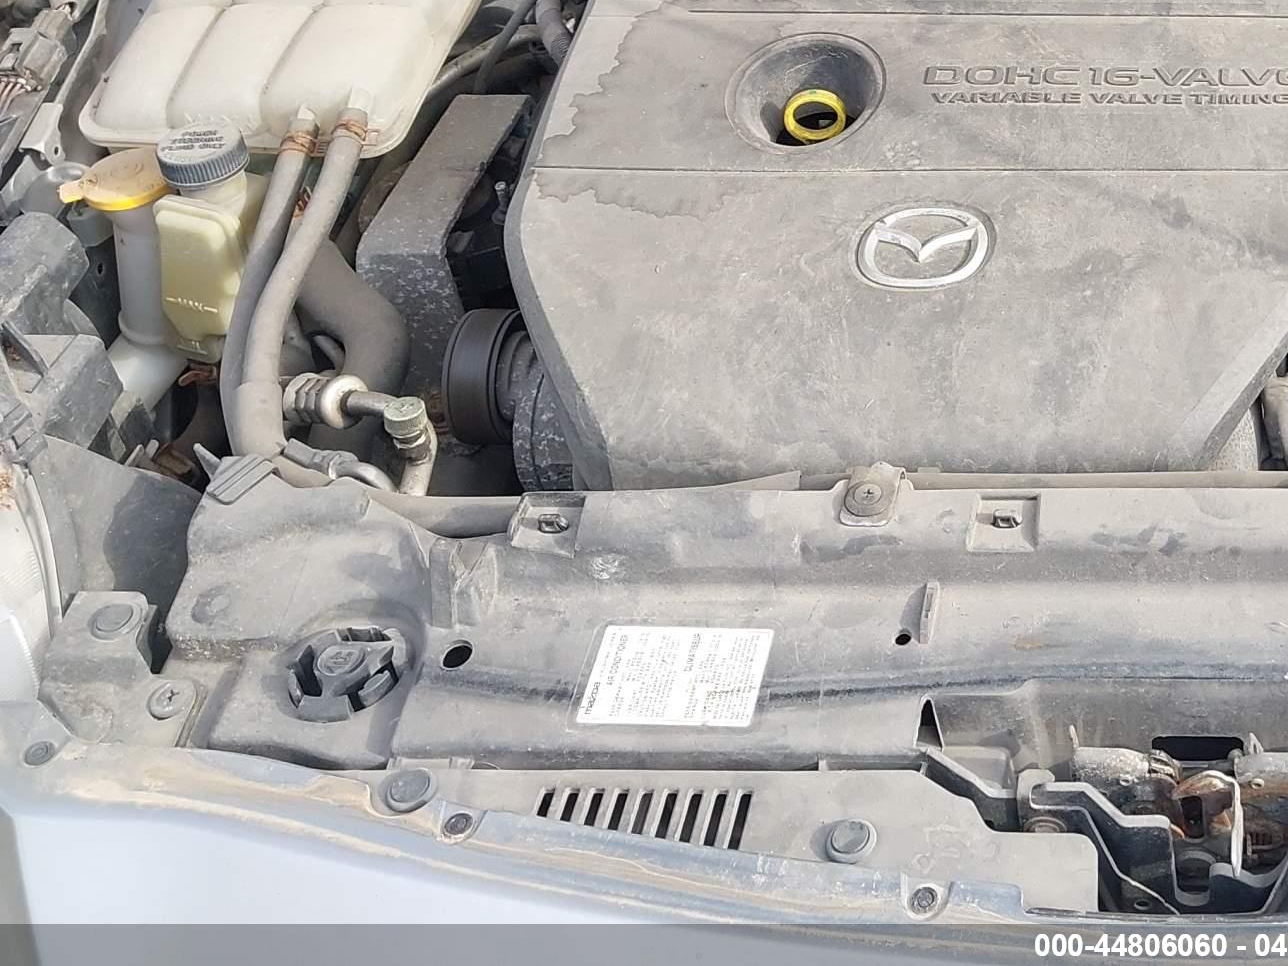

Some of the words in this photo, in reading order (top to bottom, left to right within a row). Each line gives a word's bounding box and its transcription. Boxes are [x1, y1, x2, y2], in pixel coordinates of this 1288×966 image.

[922, 65, 1080, 86] DOHC
[930, 91, 1081, 105] VARIABLE
[1088, 92, 1183, 106] VALVE
